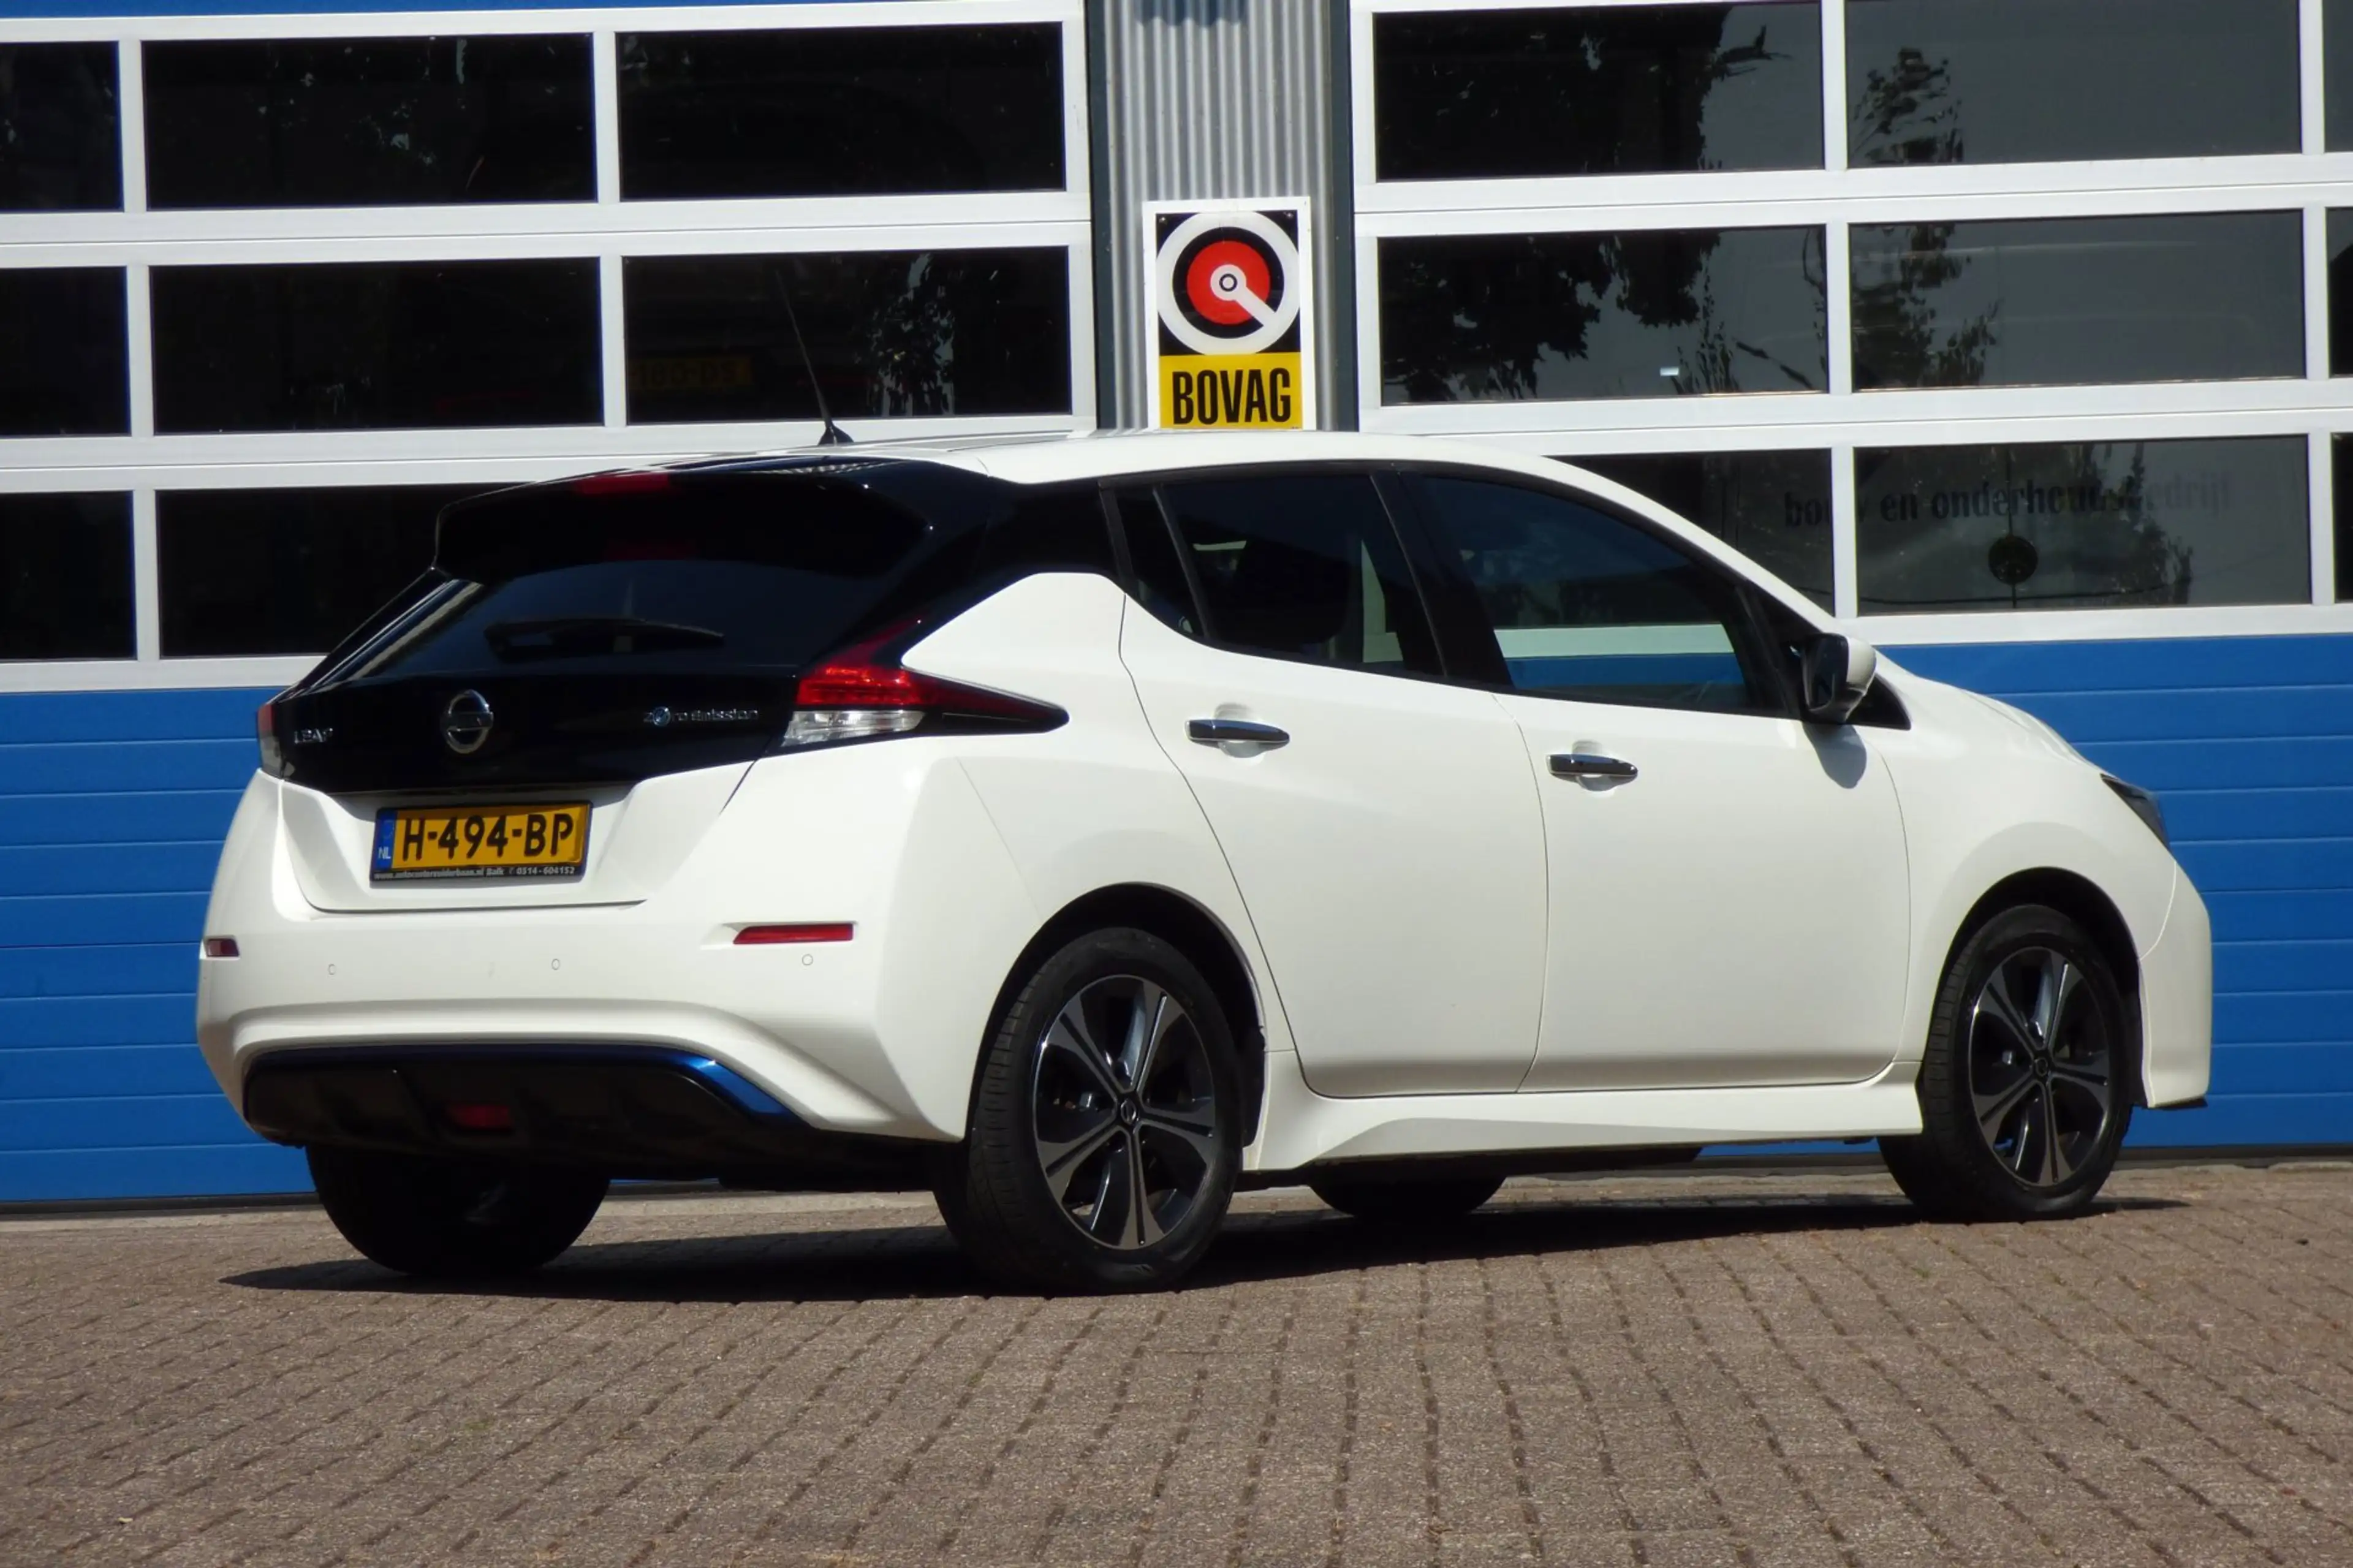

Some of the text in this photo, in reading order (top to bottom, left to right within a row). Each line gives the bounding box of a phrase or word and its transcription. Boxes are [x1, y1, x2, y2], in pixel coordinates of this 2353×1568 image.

[1172, 368, 1291, 425] BOVAG
[1880, 493, 1919, 522] en
[691, 708, 760, 722] emission
[294, 727, 334, 744] LEAF
[402, 813, 574, 862] H-494-BP
[378, 847, 391, 860] NL
